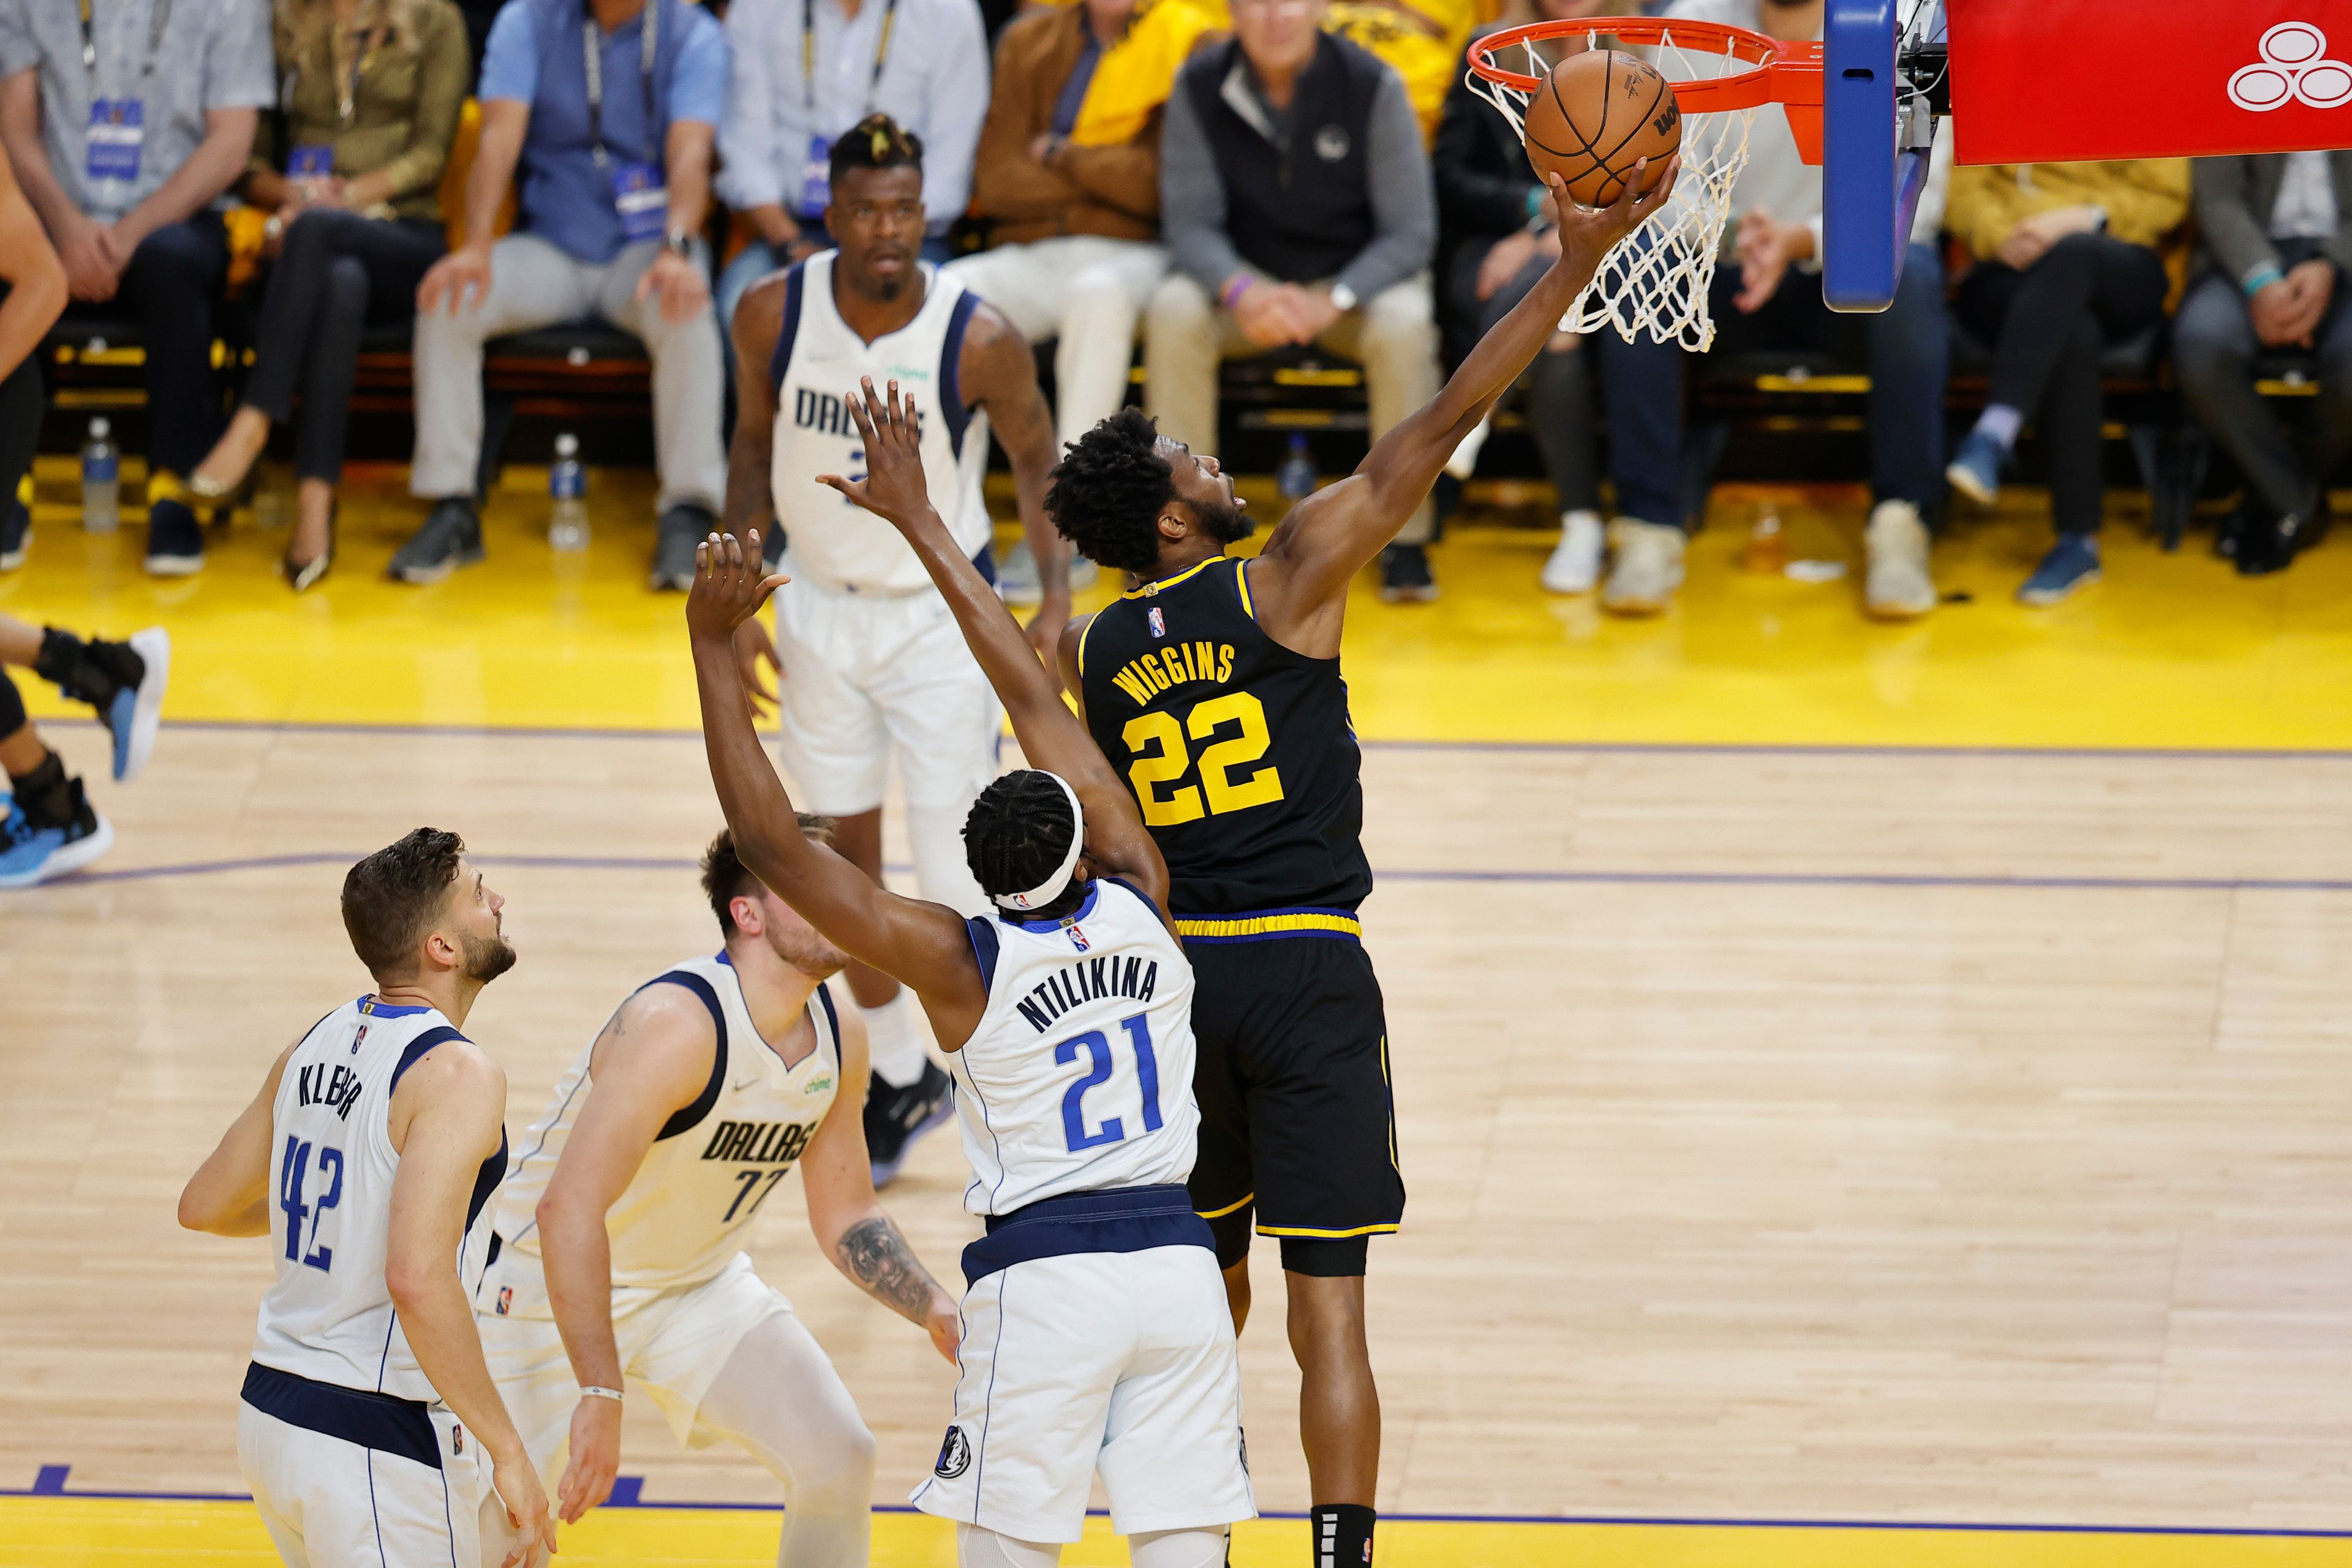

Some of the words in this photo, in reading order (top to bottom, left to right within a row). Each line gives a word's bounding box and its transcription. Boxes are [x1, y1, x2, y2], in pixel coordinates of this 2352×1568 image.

[1112, 641, 1235, 707] WIGGINS
[1121, 690, 1285, 827] 22
[1016, 956, 1158, 1034] NTILIKINA
[299, 1063, 362, 1122] KLEBER
[1054, 1011, 1164, 1155] 21
[700, 1120, 818, 1163] DALLAS
[280, 1133, 344, 1275] 42
[722, 1168, 790, 1223] 77
